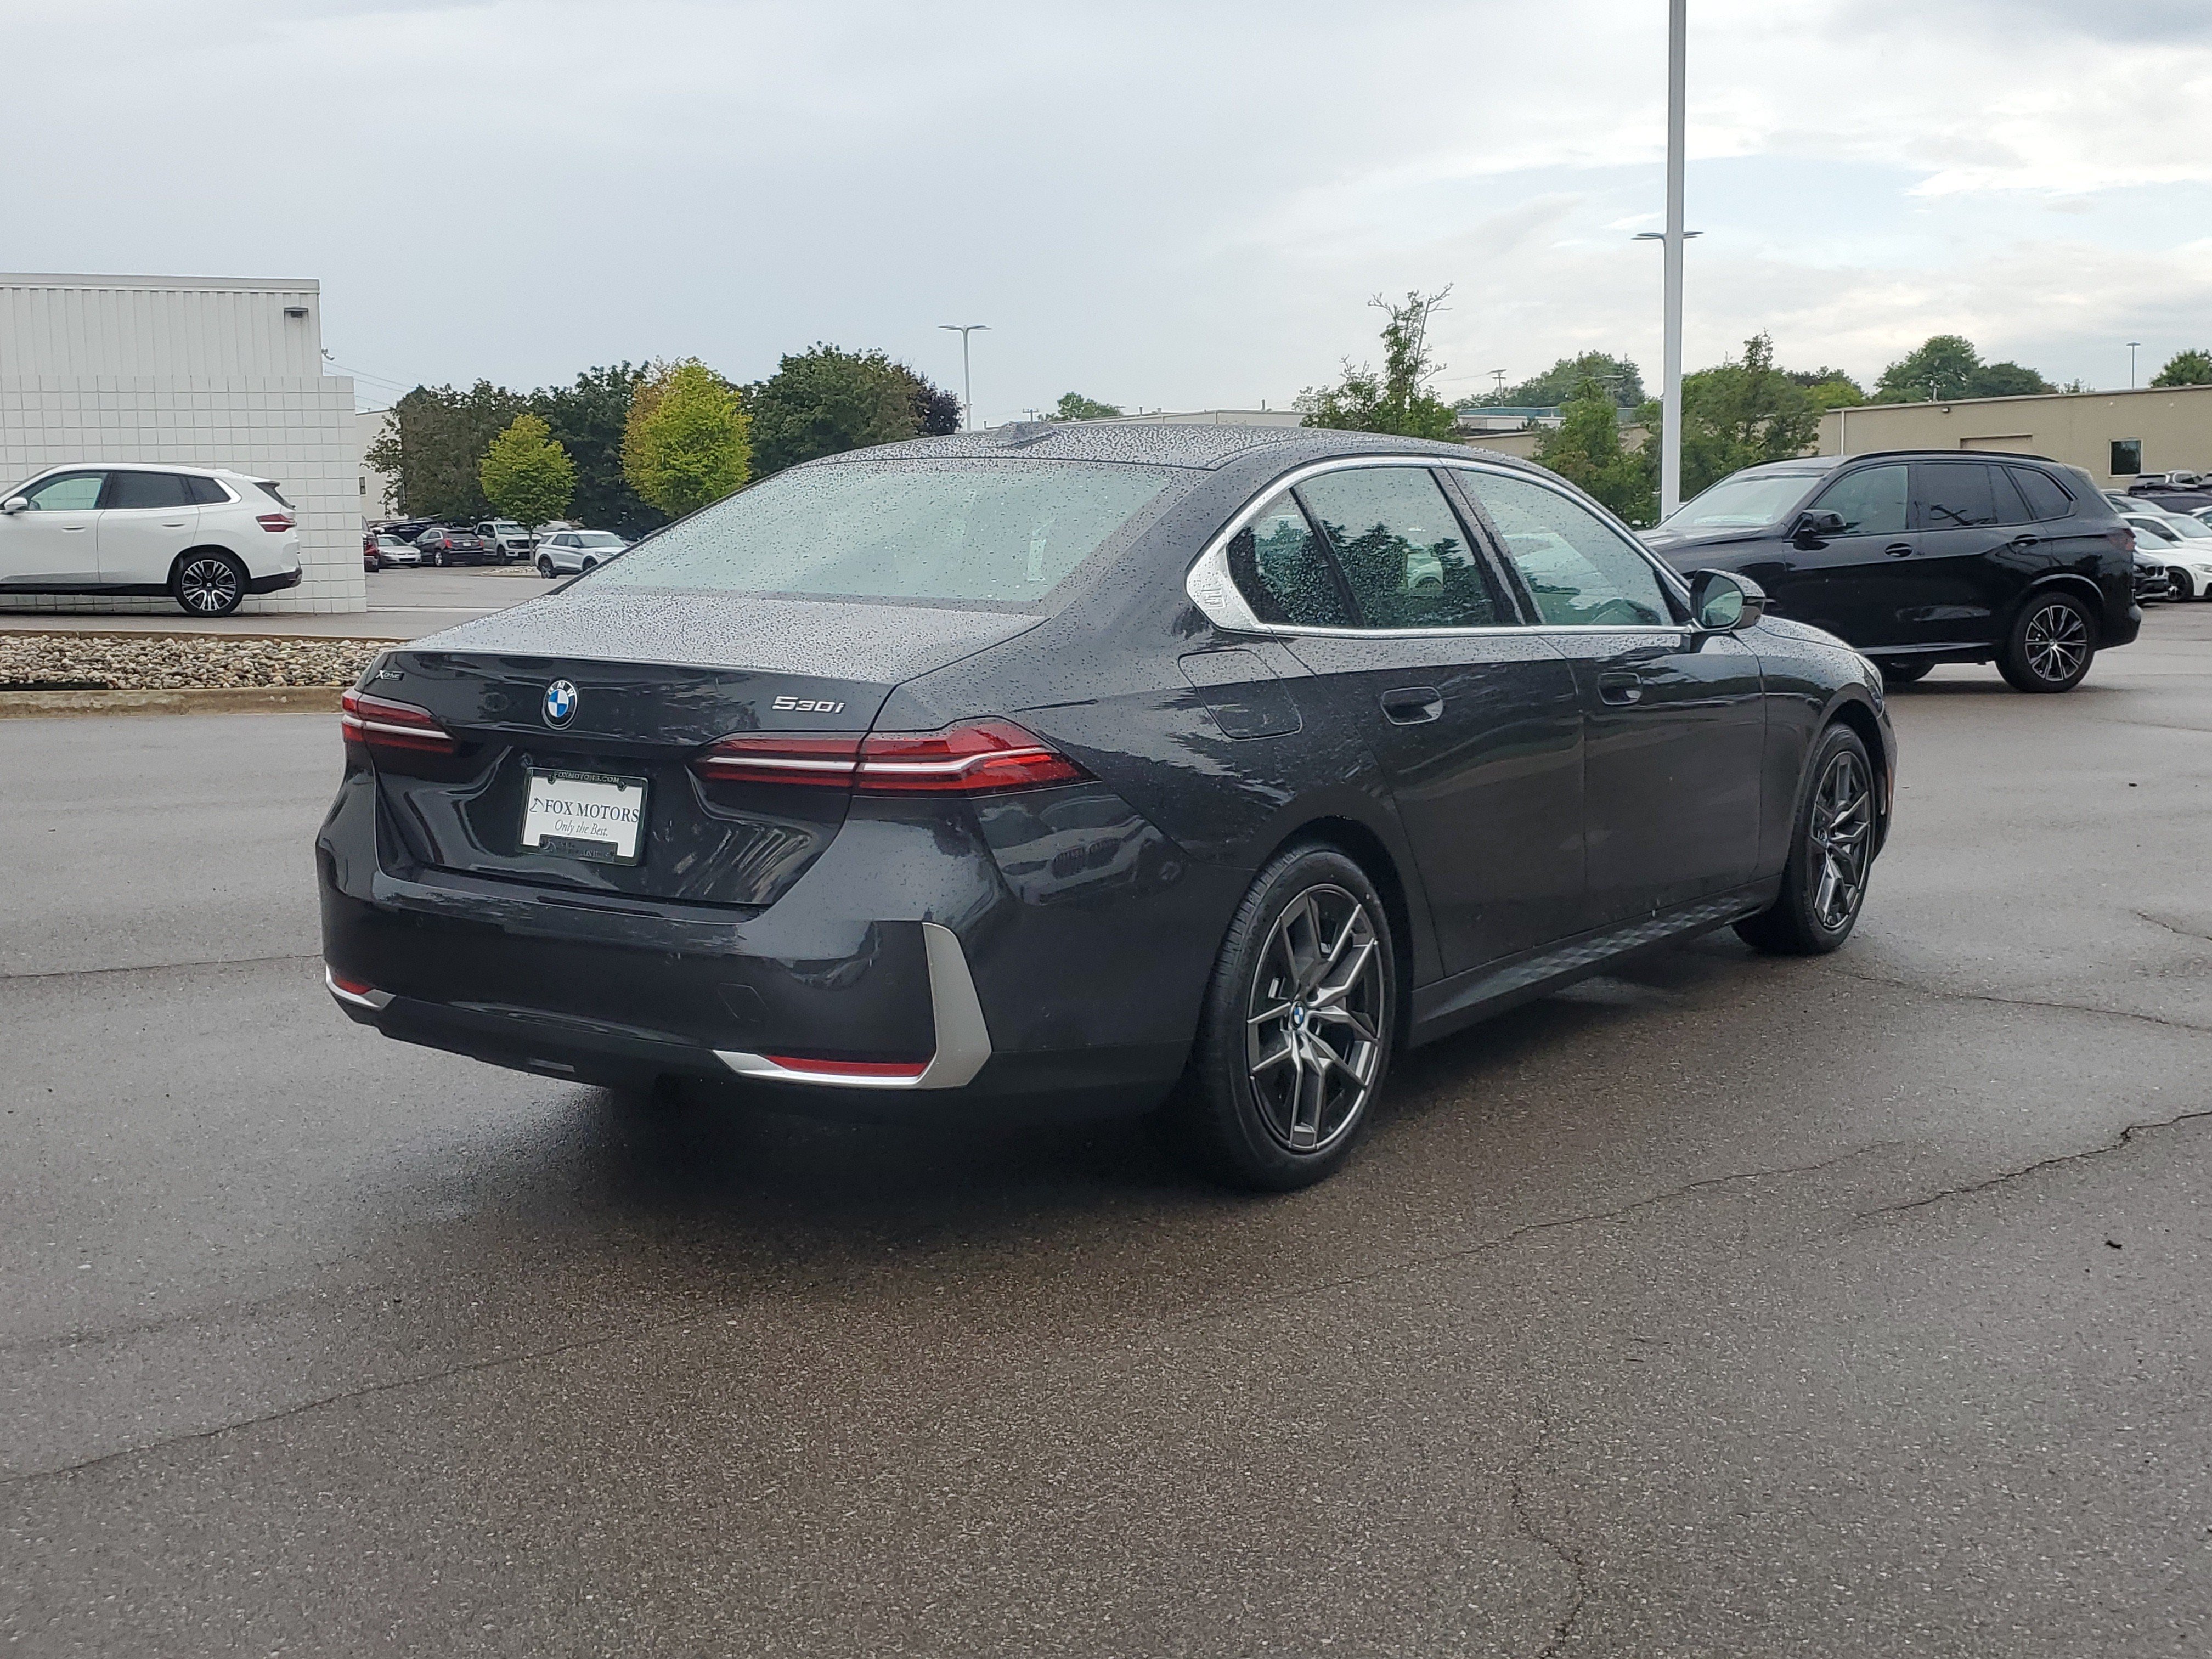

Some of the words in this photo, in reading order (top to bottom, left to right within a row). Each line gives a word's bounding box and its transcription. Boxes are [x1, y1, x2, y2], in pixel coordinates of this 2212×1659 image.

[548, 682, 574, 697] BMW
[772, 696, 845, 713] 530i
[544, 799, 574, 816] FOX
[575, 802, 639, 823] MOTORS
[555, 819, 575, 836] Only
[576, 821, 589, 834] the
[591, 823, 608, 836] Best.
